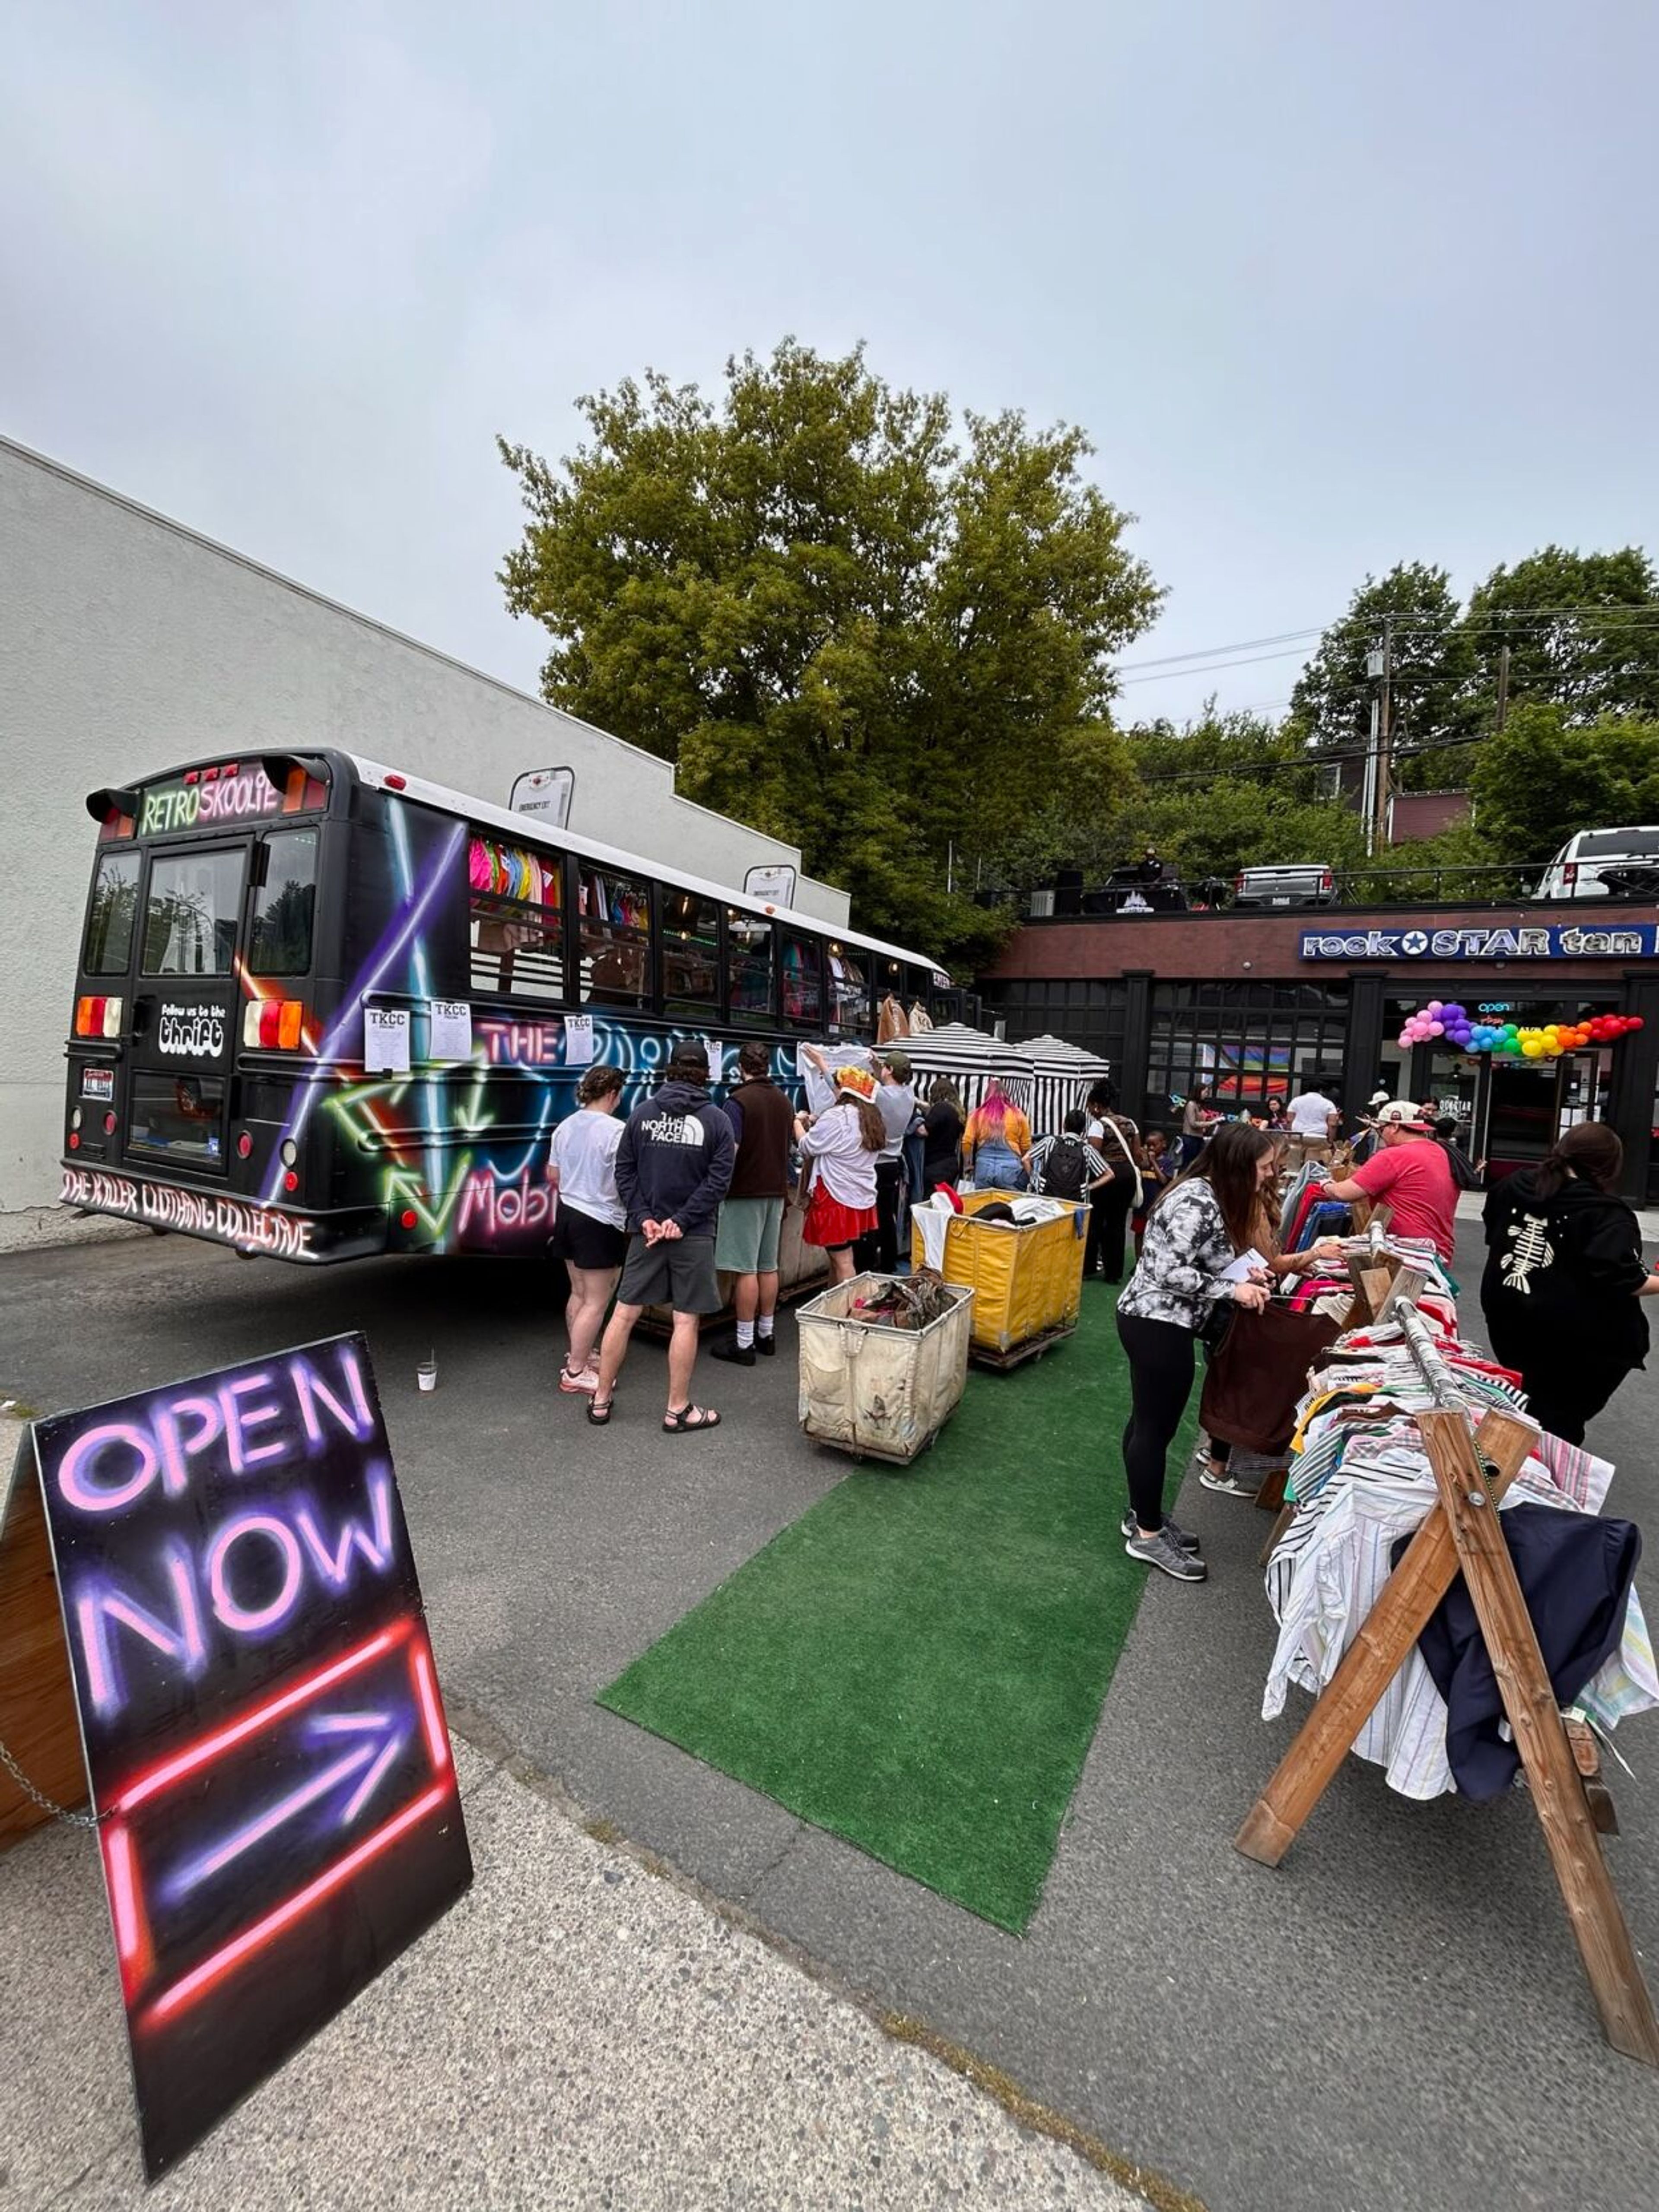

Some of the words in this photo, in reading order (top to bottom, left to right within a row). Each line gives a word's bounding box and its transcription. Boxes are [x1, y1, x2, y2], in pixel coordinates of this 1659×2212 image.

[1303, 931, 1400, 956] rock
[1432, 929, 1550, 956] STAR
[1560, 927, 1642, 954] tan
[186, 1007, 197, 1016] us
[198, 1004, 209, 1017] to
[210, 1005, 226, 1018] the
[435, 1004, 466, 1016] TKCC
[1478, 1003, 1510, 1013] open
[370, 1012, 405, 1025] TKCC
[568, 1018, 590, 1028] TKCC
[159, 1016, 223, 1057] thrift
[479, 1022, 558, 1063] THE
[641, 1120, 684, 1133] NORTH
[651, 1130, 682, 1143] FACE
[58, 1169, 91, 1202] THE
[90, 1171, 137, 1213] KILLER
[142, 1183, 215, 1229] CLOTHING
[217, 1202, 320, 1259] COLLECTIVE
[58, 1347, 374, 1512] OPEN
[74, 1466, 394, 1718] NOW
